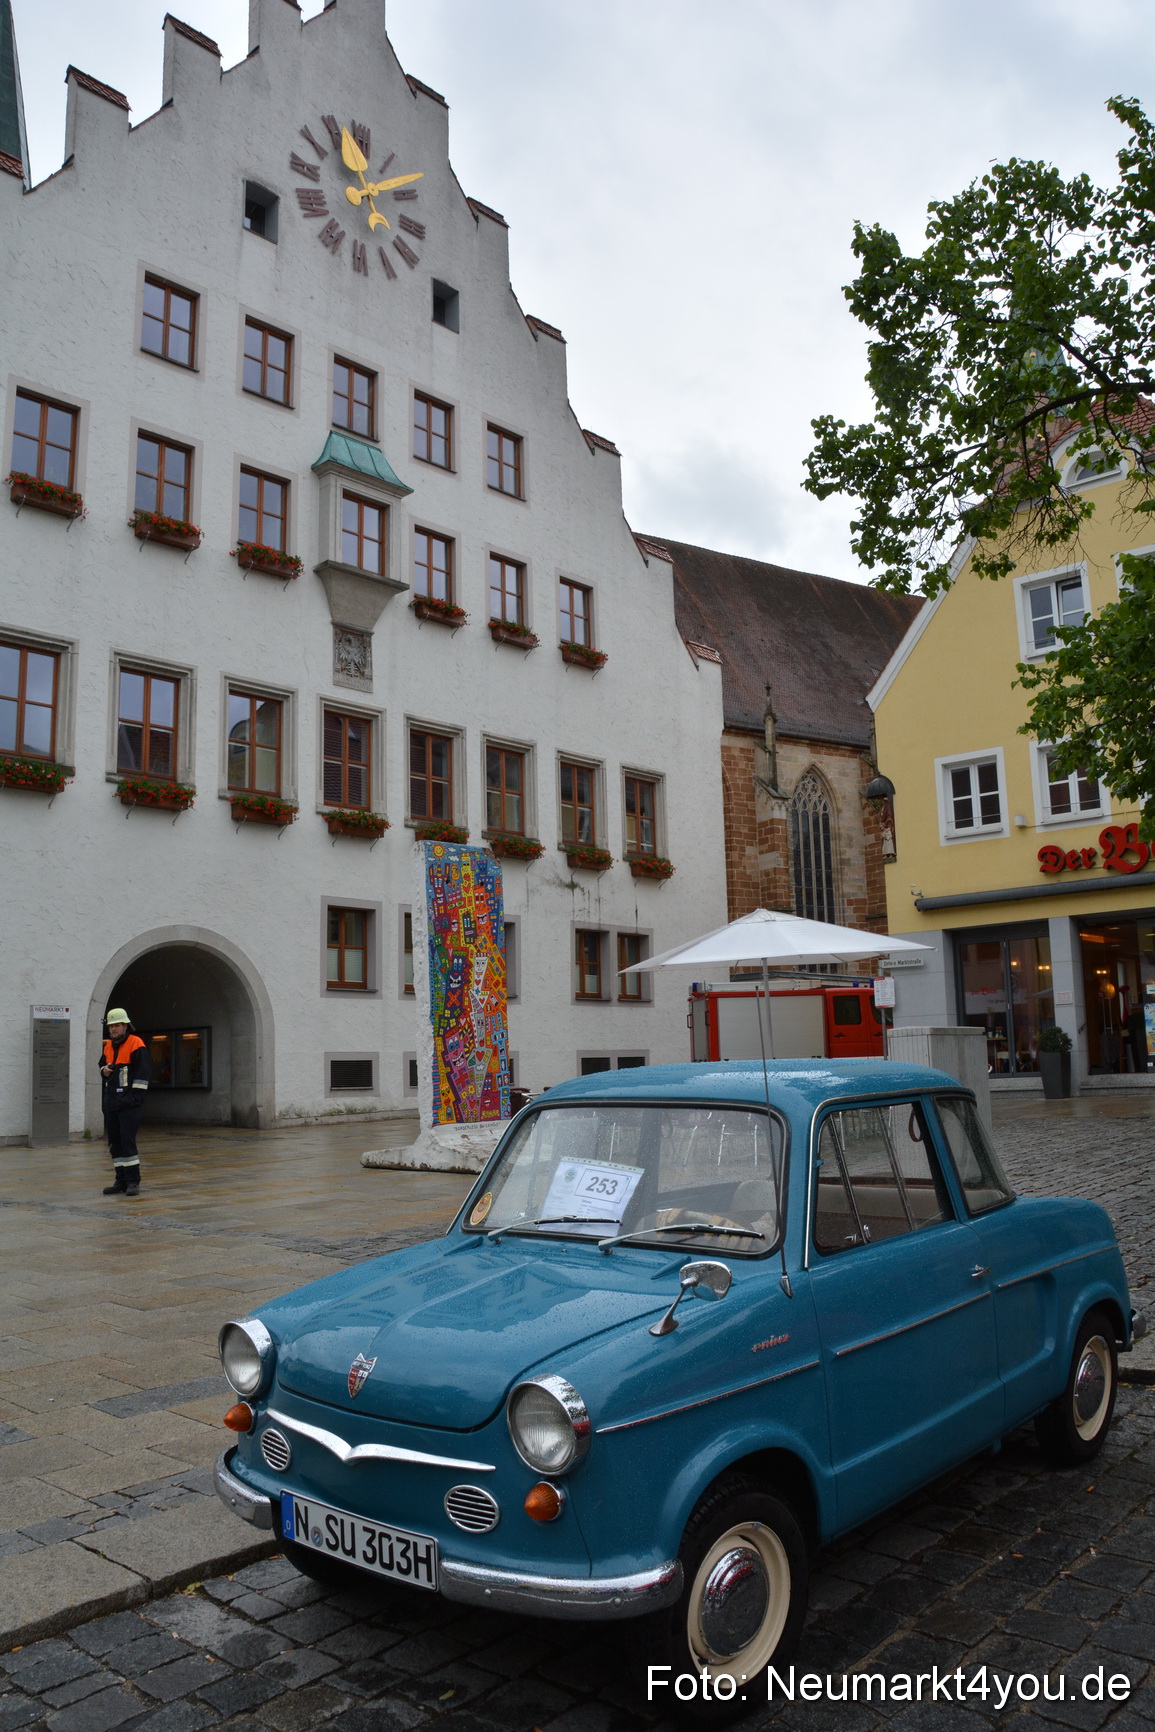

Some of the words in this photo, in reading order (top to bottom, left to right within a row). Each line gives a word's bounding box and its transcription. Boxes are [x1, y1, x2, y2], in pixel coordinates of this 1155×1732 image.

[1037, 844, 1097, 873] Der
[1098, 822, 1155, 874] B
[586, 1176, 618, 1195] 253
[294, 1501, 310, 1541] N
[325, 1513, 356, 1559] SU
[362, 1525, 433, 1583] 303H
